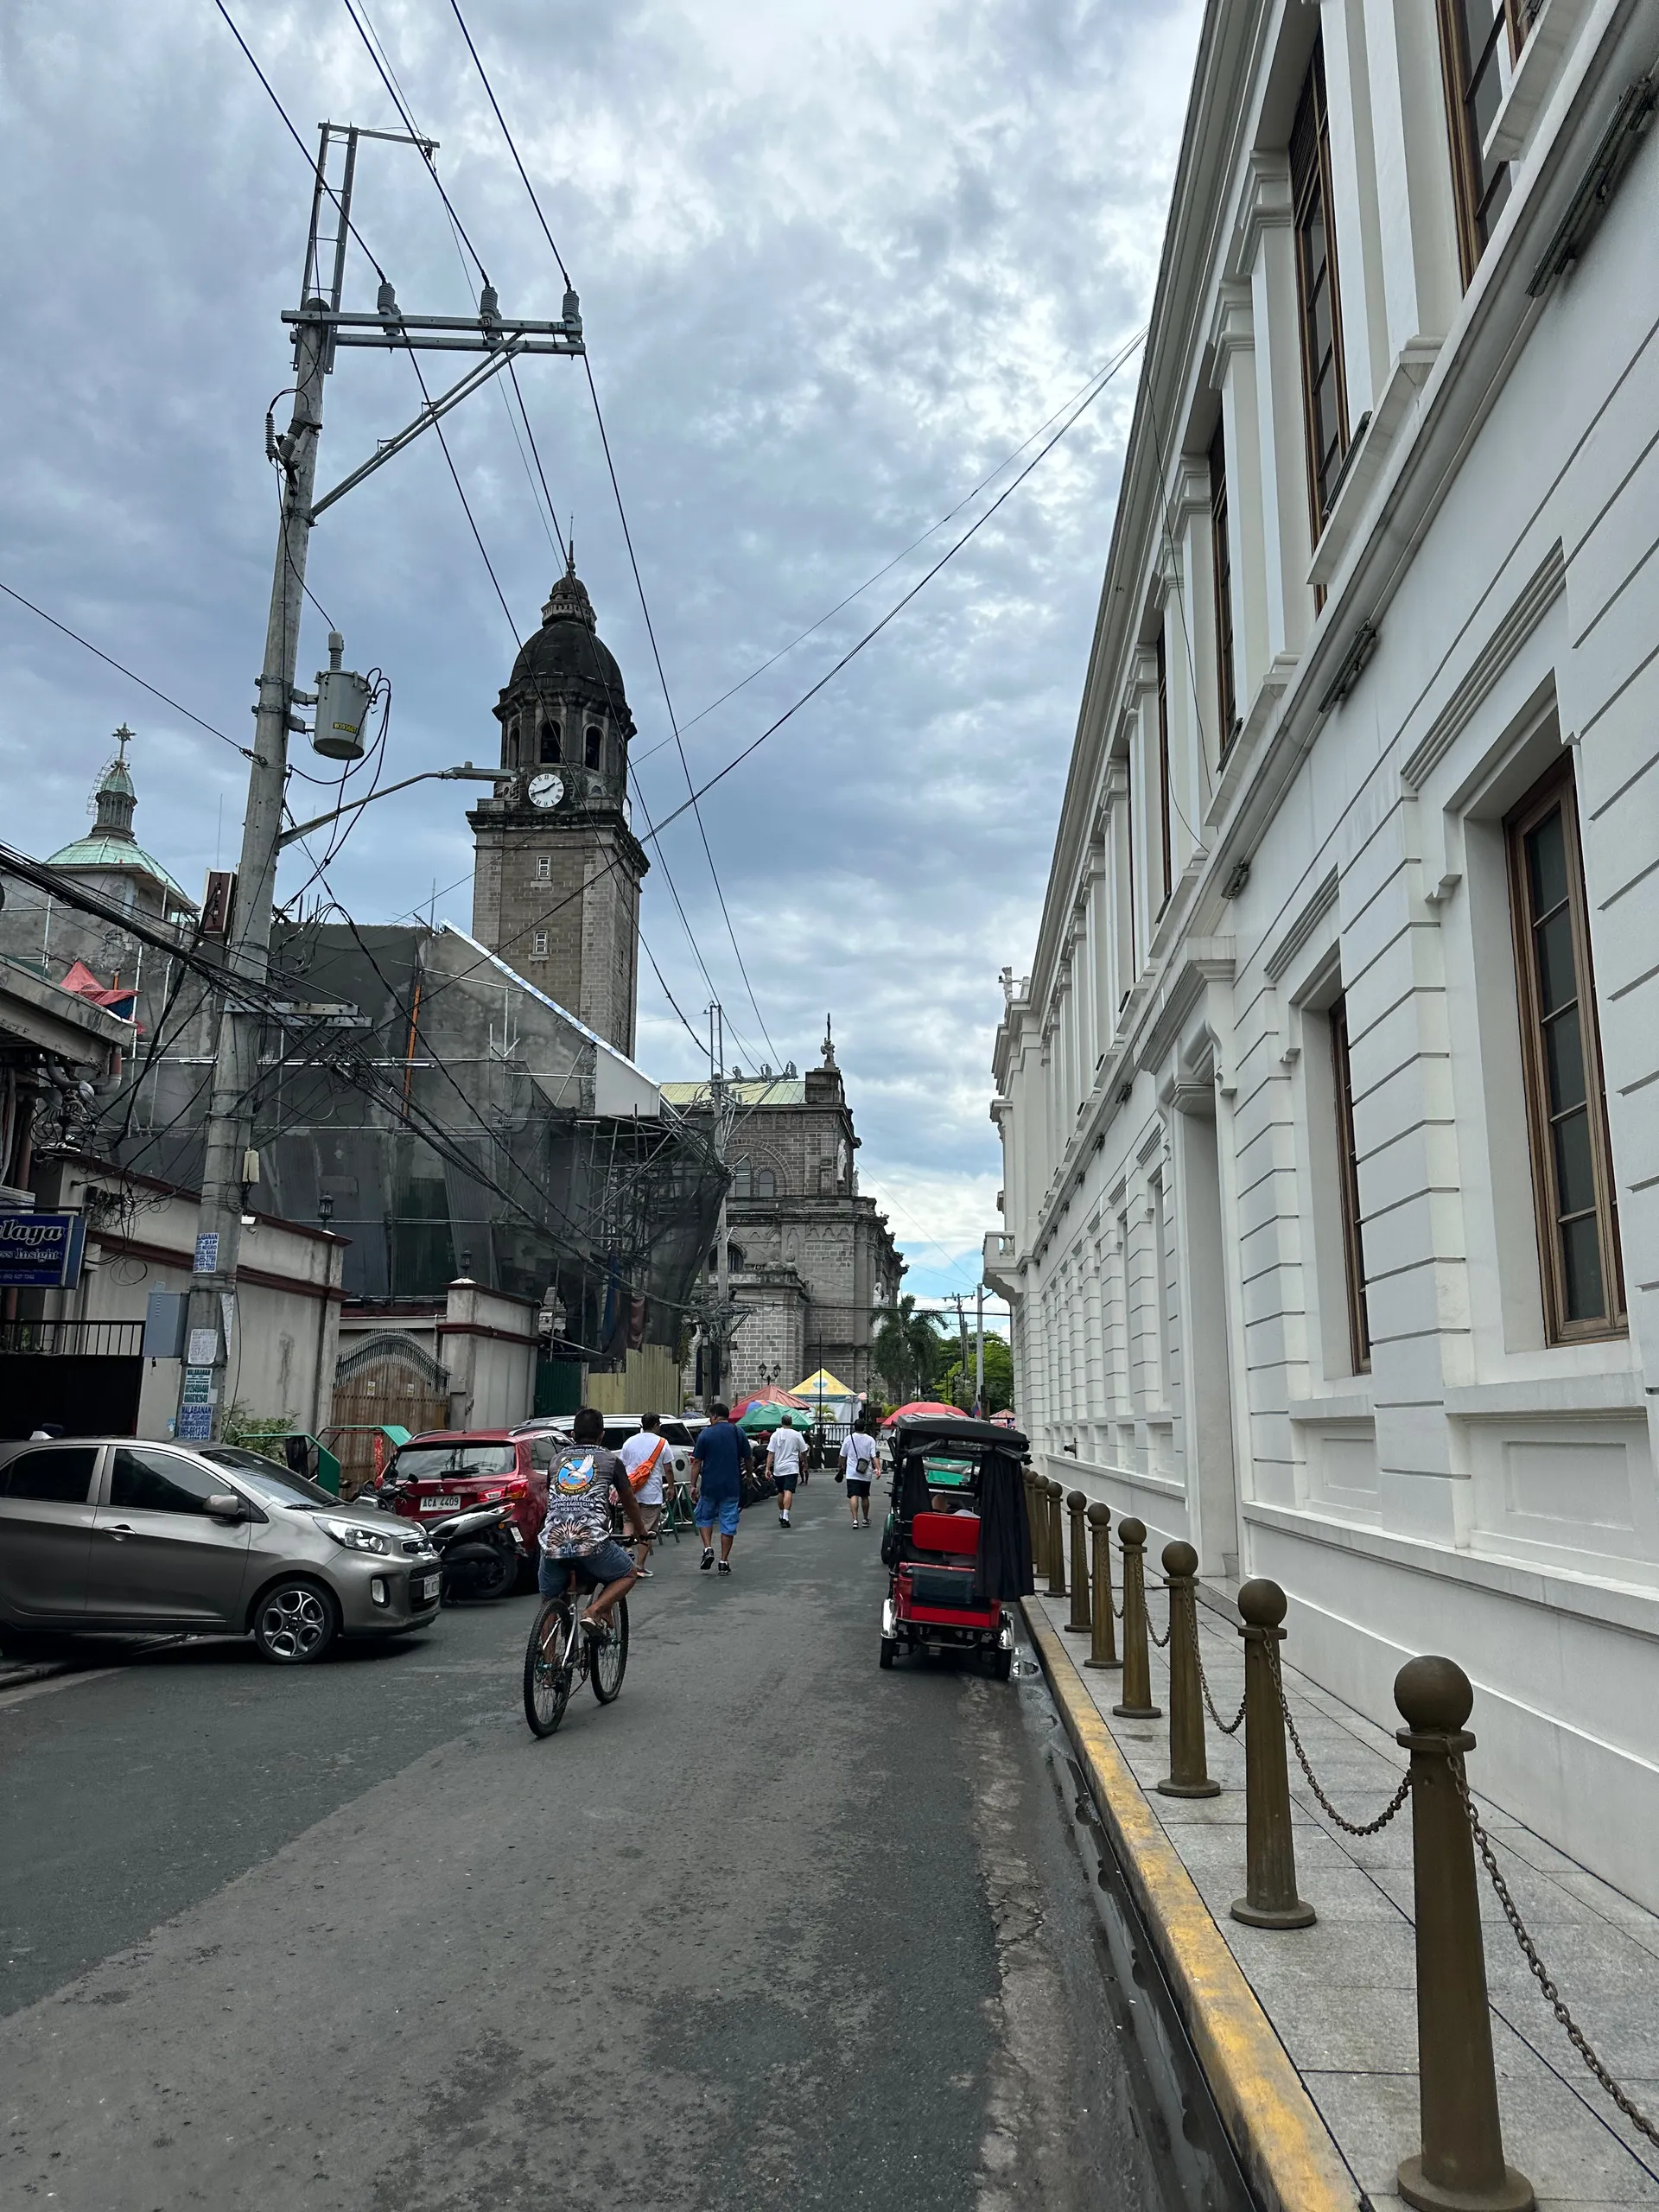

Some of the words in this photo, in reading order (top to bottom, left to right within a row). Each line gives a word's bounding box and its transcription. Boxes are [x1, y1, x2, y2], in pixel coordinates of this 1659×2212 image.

[15, 1248, 60, 1262] Insight
[181, 1405, 212, 1414] MALABANAN
[423, 1498, 437, 1507] ACA
[440, 1497, 459, 1506] 4409
